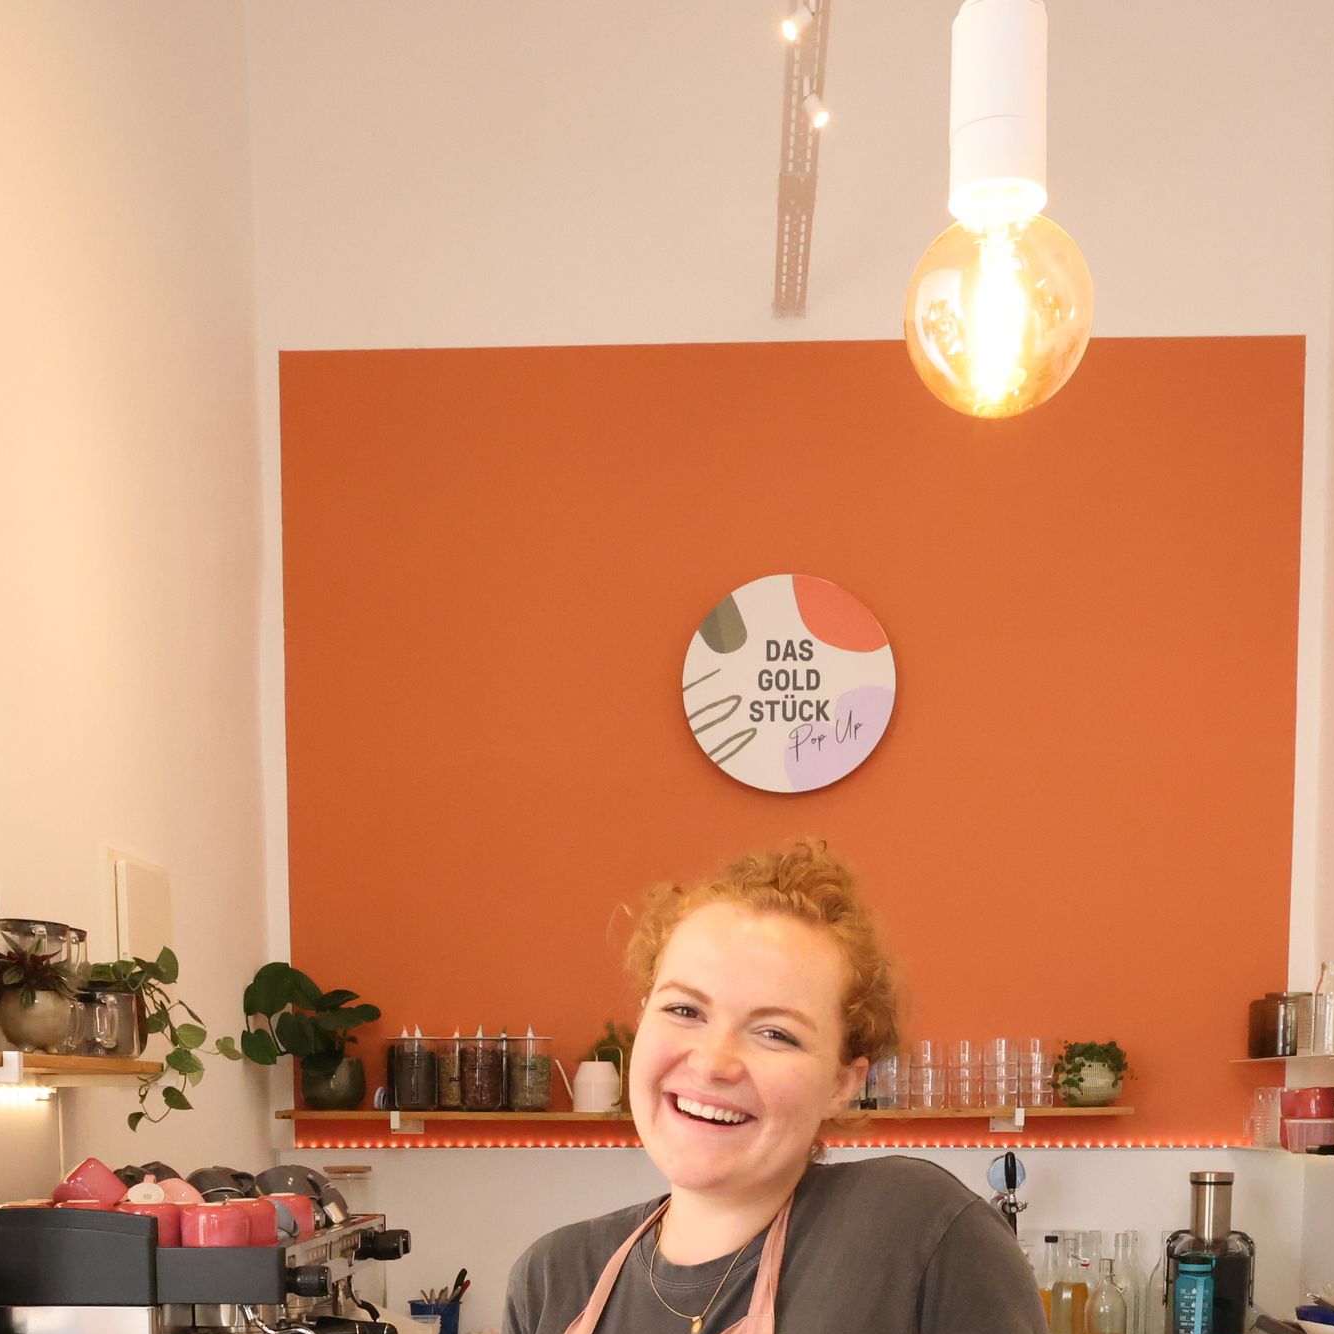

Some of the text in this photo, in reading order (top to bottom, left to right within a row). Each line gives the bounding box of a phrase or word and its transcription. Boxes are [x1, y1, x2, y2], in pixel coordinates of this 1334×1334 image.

[766, 640, 814, 661] DAS
[758, 669, 821, 691] GOLD
[749, 694, 830, 722] STÜCK
[788, 710, 863, 762] Pop Up
